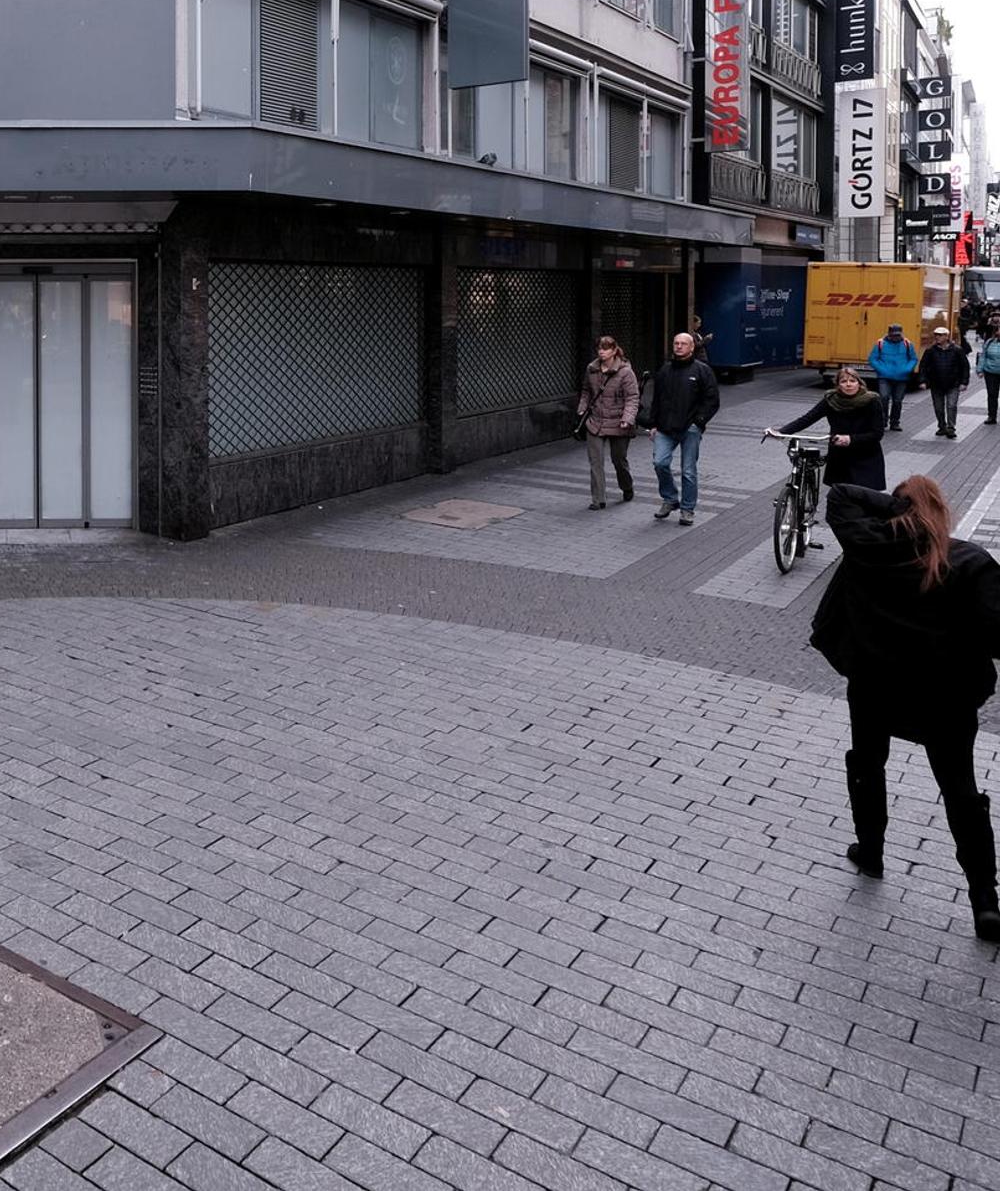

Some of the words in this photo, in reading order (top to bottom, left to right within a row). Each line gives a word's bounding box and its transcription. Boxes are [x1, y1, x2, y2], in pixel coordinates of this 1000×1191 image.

[711, 26, 740, 147] EUROPA
[852, 97, 874, 118] 17
[848, 127, 873, 210] GÖRTZ
[825, 293, 900, 307] DHL
